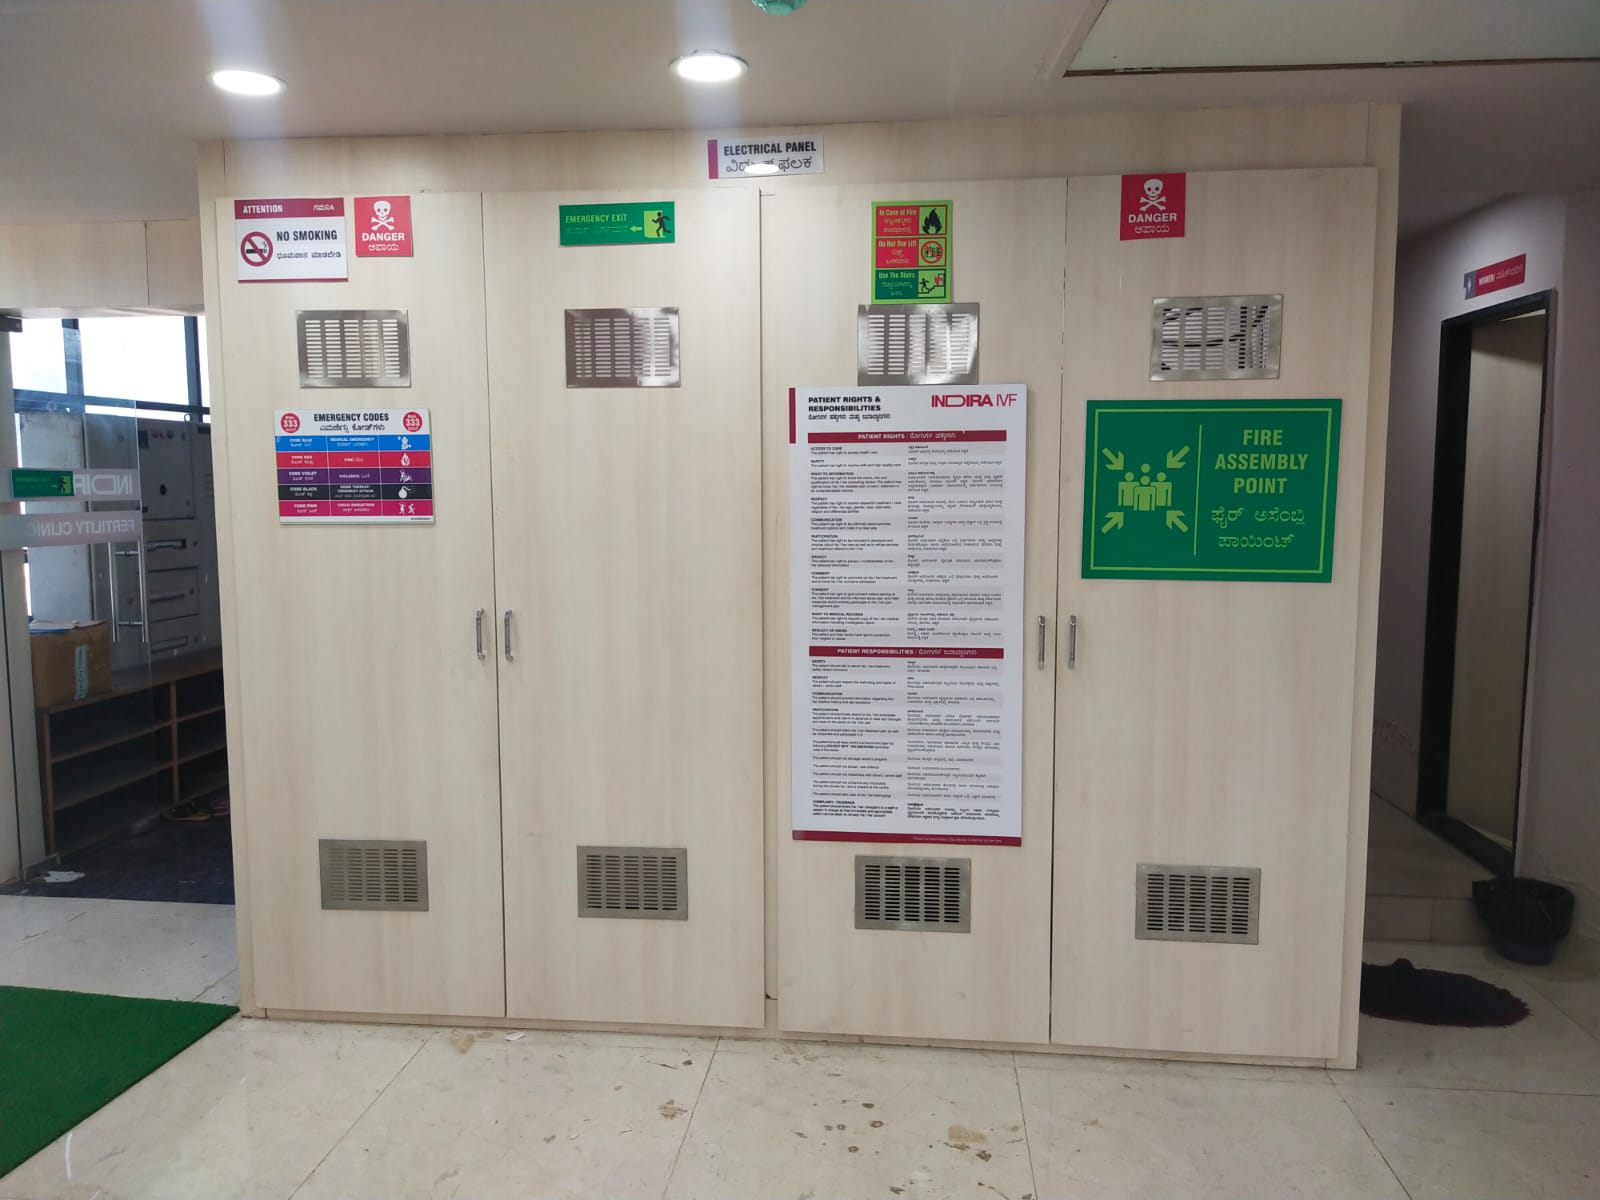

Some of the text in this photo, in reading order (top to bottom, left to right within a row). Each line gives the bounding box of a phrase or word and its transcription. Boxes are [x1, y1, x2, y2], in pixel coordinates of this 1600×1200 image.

[724, 141, 816, 156] ELECTRICAL PANEL
[778, 156, 812, 172] ಫಲಕ
[243, 205, 283, 214] ATTENTION
[565, 213, 628, 223] EMERGENCY EXIT
[1128, 213, 1177, 223] DANGER
[277, 230, 337, 241] NO SMOKING
[362, 232, 405, 242] DANGER
[931, 393, 1018, 408] INDIRA IVF
[283, 419, 298, 428] 333
[314, 413, 389, 422] EMERGENCY CODES
[405, 418, 420, 427] 333
[1243, 429, 1283, 446] FIRE
[1215, 453, 1309, 470] ASSEMBLY
[1233, 477, 1288, 494] POINT
[1211, 506, 1305, 528] ಫೈರ್ ಅಸೆಂಬ್ಲಿ
[1218, 534, 1295, 548] ಪಾಯಿಂಟ್
